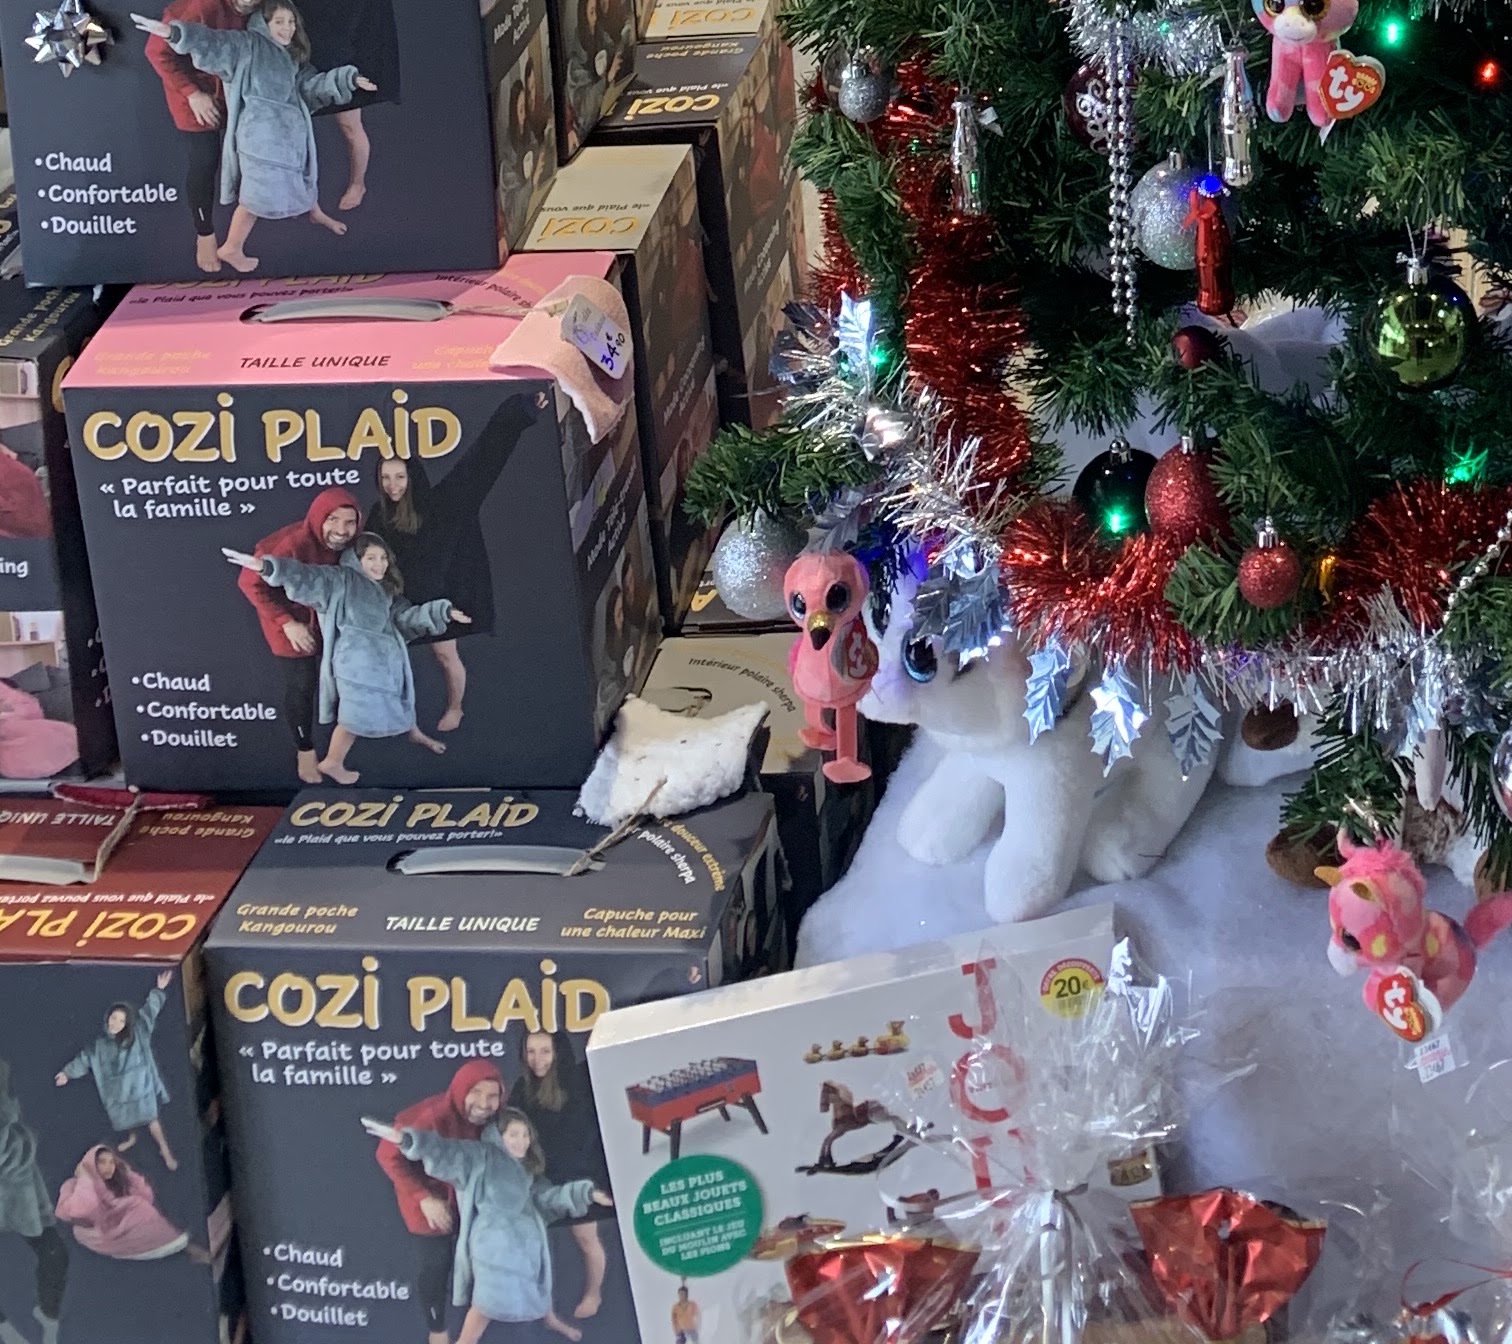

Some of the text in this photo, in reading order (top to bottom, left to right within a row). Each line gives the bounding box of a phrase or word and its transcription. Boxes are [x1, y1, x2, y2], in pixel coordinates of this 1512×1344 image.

[1329, 66, 1365, 112] ty
[45, 152, 112, 172] Chaud
[48, 183, 178, 205] Confortable
[51, 216, 136, 235] Douillet
[34, 287, 62, 311] poch
[240, 355, 392, 369] TAILLE UNIQUE
[122, 465, 360, 500] Parfait pour toute
[114, 496, 232, 519] la famille
[143, 672, 210, 692] Chaud
[689, 657, 797, 713] Intérieur polaire sherpa
[147, 701, 277, 722] Confortable
[152, 729, 238, 749] Douillet
[637, 830, 696, 885] polaire sherpa
[236, 904, 359, 919] Grande poche
[583, 907, 698, 923] Capuche pour
[239, 920, 338, 936] Kangourou
[385, 915, 541, 932] TAILLE UNIQUE
[560, 923, 708, 941] une chaleur Maxi
[262, 1039, 505, 1063] Parfait pour toute
[252, 1063, 373, 1085] la famille
[660, 1170, 724, 1195] LES PLUS
[643, 1180, 748, 1214] BEAUX JOUETS
[653, 1197, 742, 1226] CLASSIQUES
[274, 1244, 343, 1268] Chaud
[277, 1273, 410, 1300] Confortable
[280, 1303, 368, 1327] Douillet
